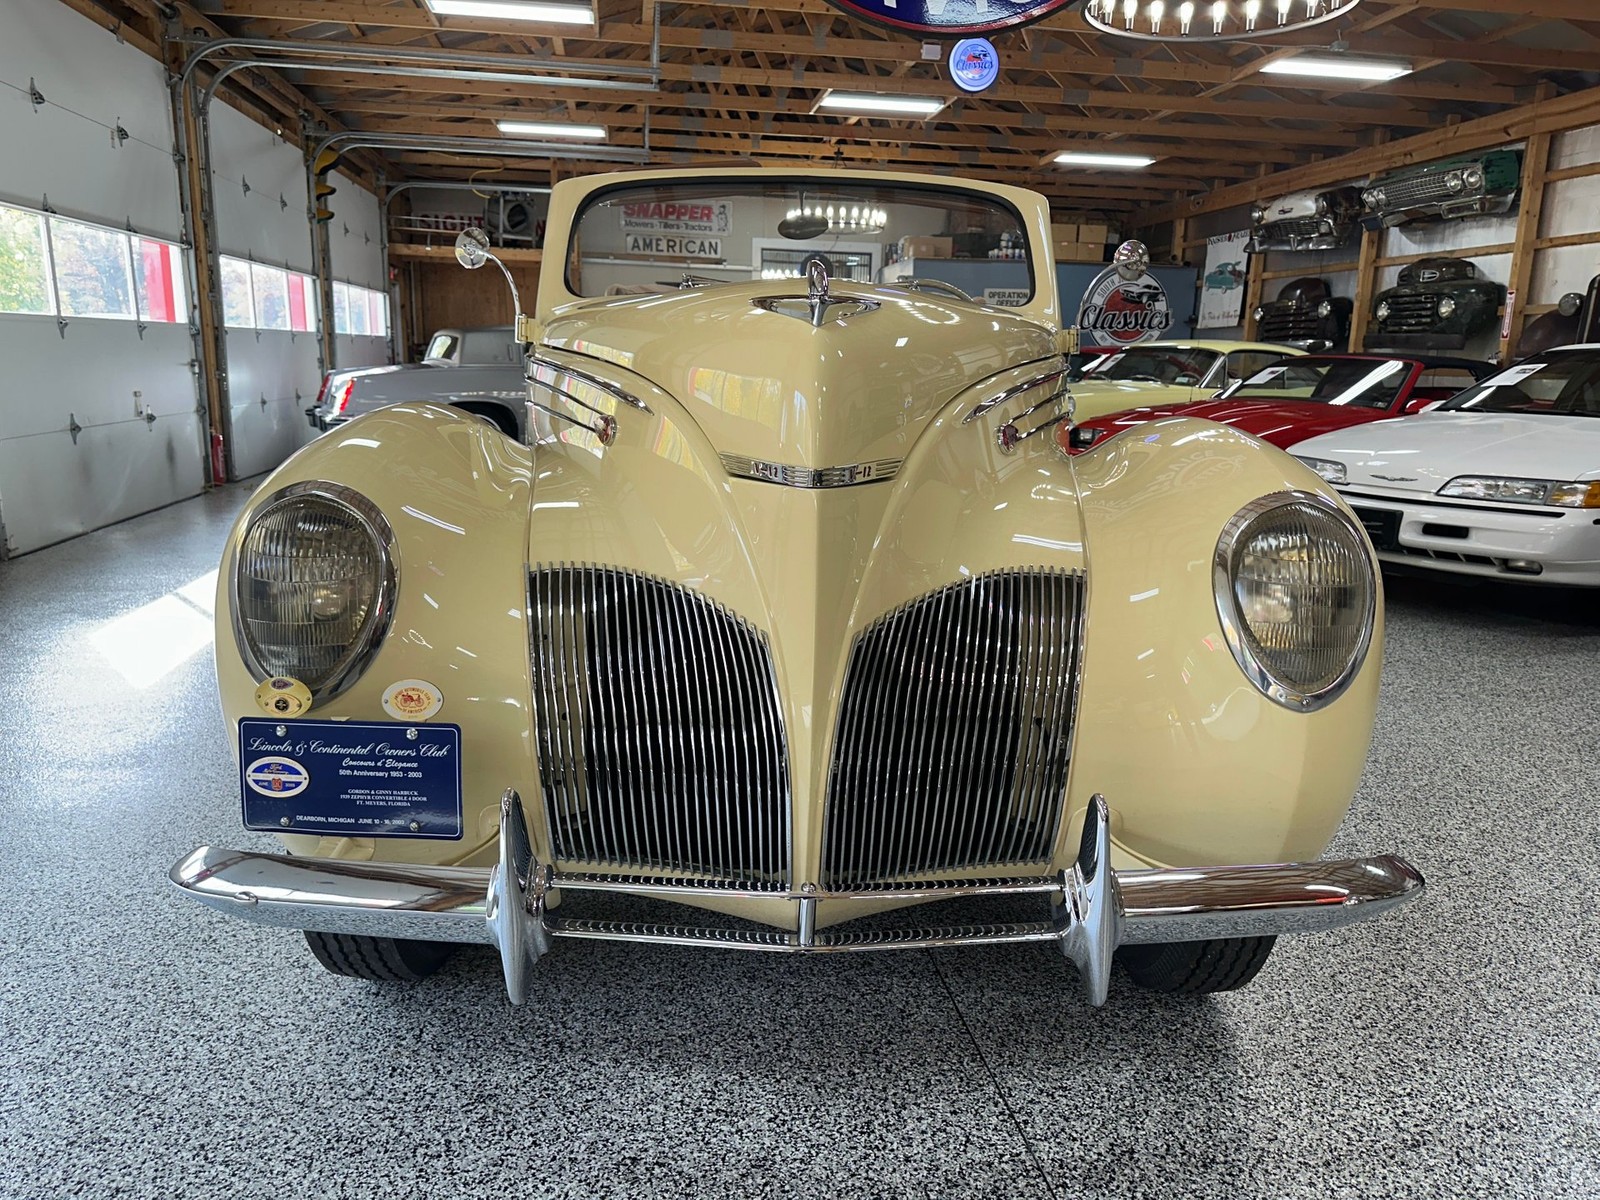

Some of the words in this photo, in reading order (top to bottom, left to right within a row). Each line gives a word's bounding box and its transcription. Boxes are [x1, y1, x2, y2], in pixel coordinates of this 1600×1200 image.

[623, 203, 714, 222] SNAPPER
[624, 219, 655, 228] Mowers
[658, 221, 680, 230] Tillers
[683, 222, 713, 232] Tractors
[631, 237, 718, 255] AMERICAN
[988, 290, 1028, 300] OPERATION
[1096, 278, 1118, 299] SOUTH
[1080, 304, 1171, 330] Classics
[247, 737, 293, 752] Lincoln
[294, 741, 307, 757] &
[309, 740, 376, 756] Continental
[375, 742, 417, 757] Owners
[419, 743, 452, 758] Club
[342, 757, 375, 767] Concours
[353, 769, 388, 778] Anniversary
[390, 770, 404, 778] 1953
[328, 816, 355, 824] MICHIGAN
